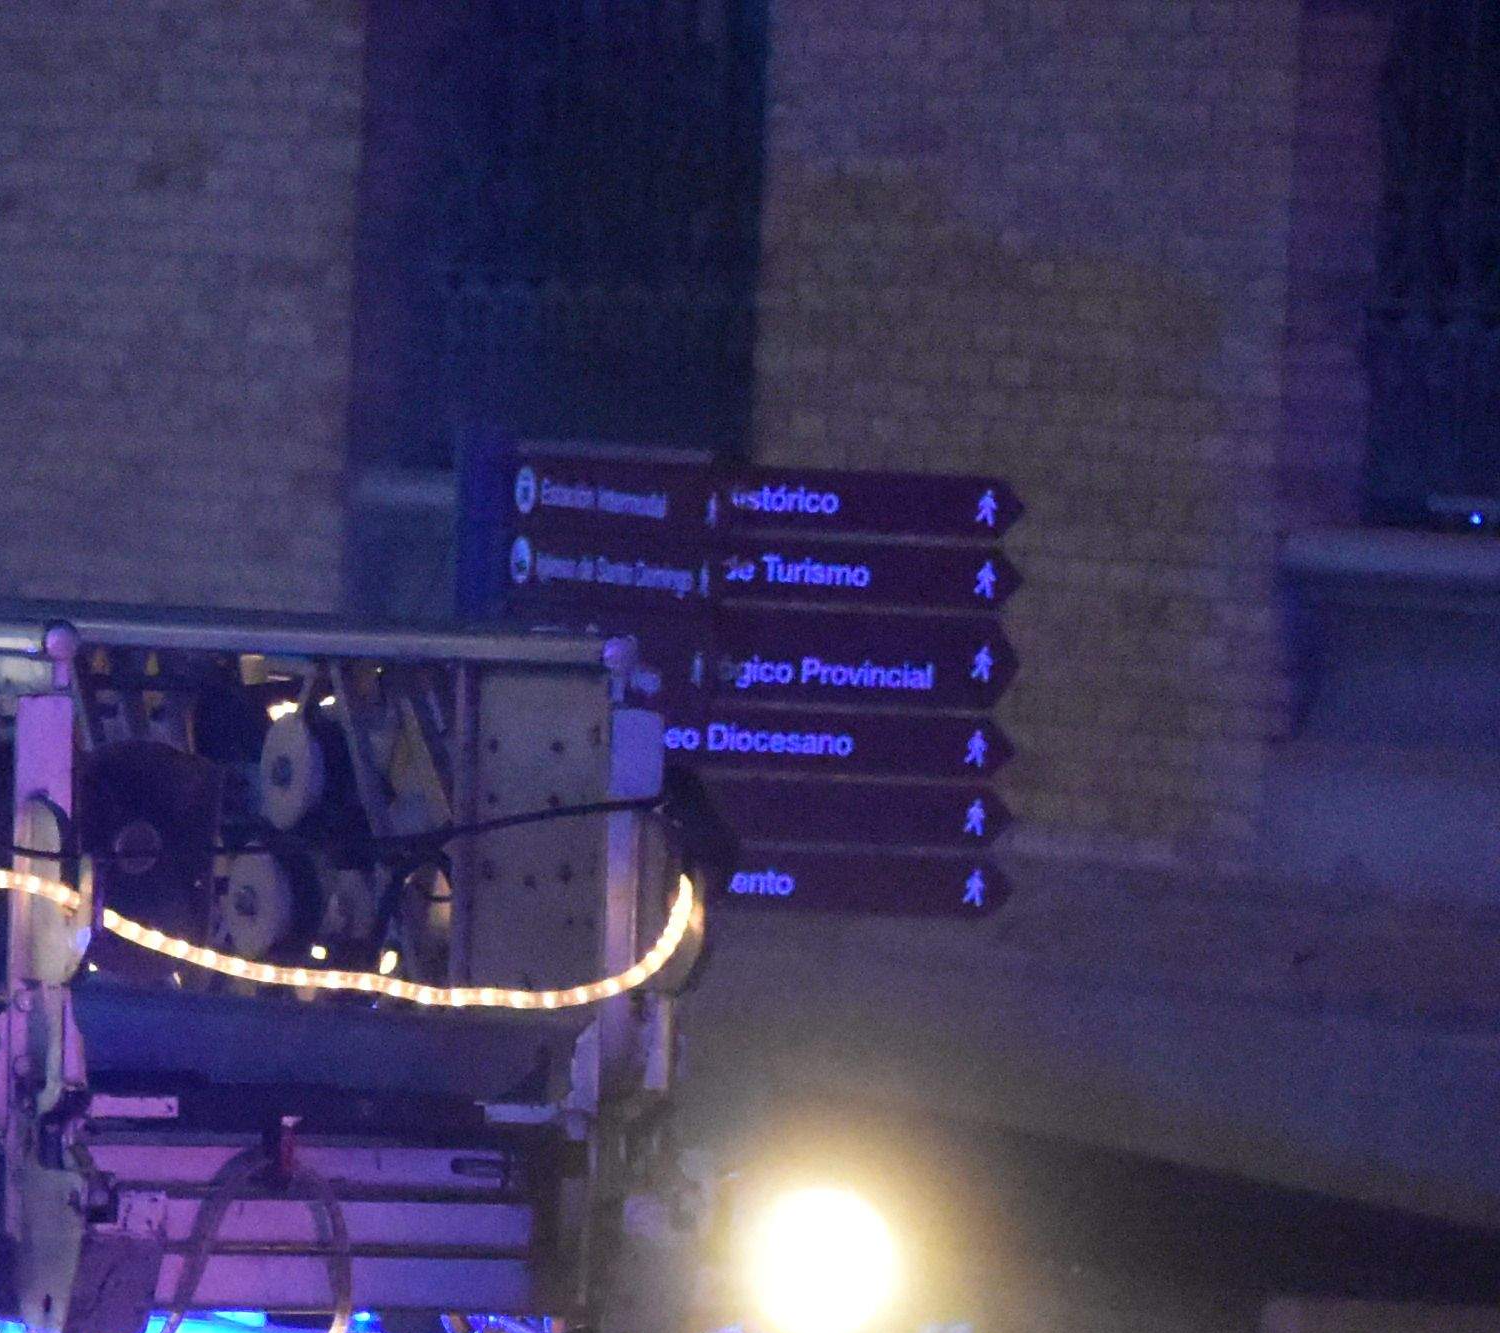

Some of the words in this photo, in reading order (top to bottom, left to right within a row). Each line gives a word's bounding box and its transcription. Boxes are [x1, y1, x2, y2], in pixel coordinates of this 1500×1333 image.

[762, 553, 871, 587] Turismo
[801, 656, 933, 689] Provincial
[707, 722, 854, 757] Diocesano
